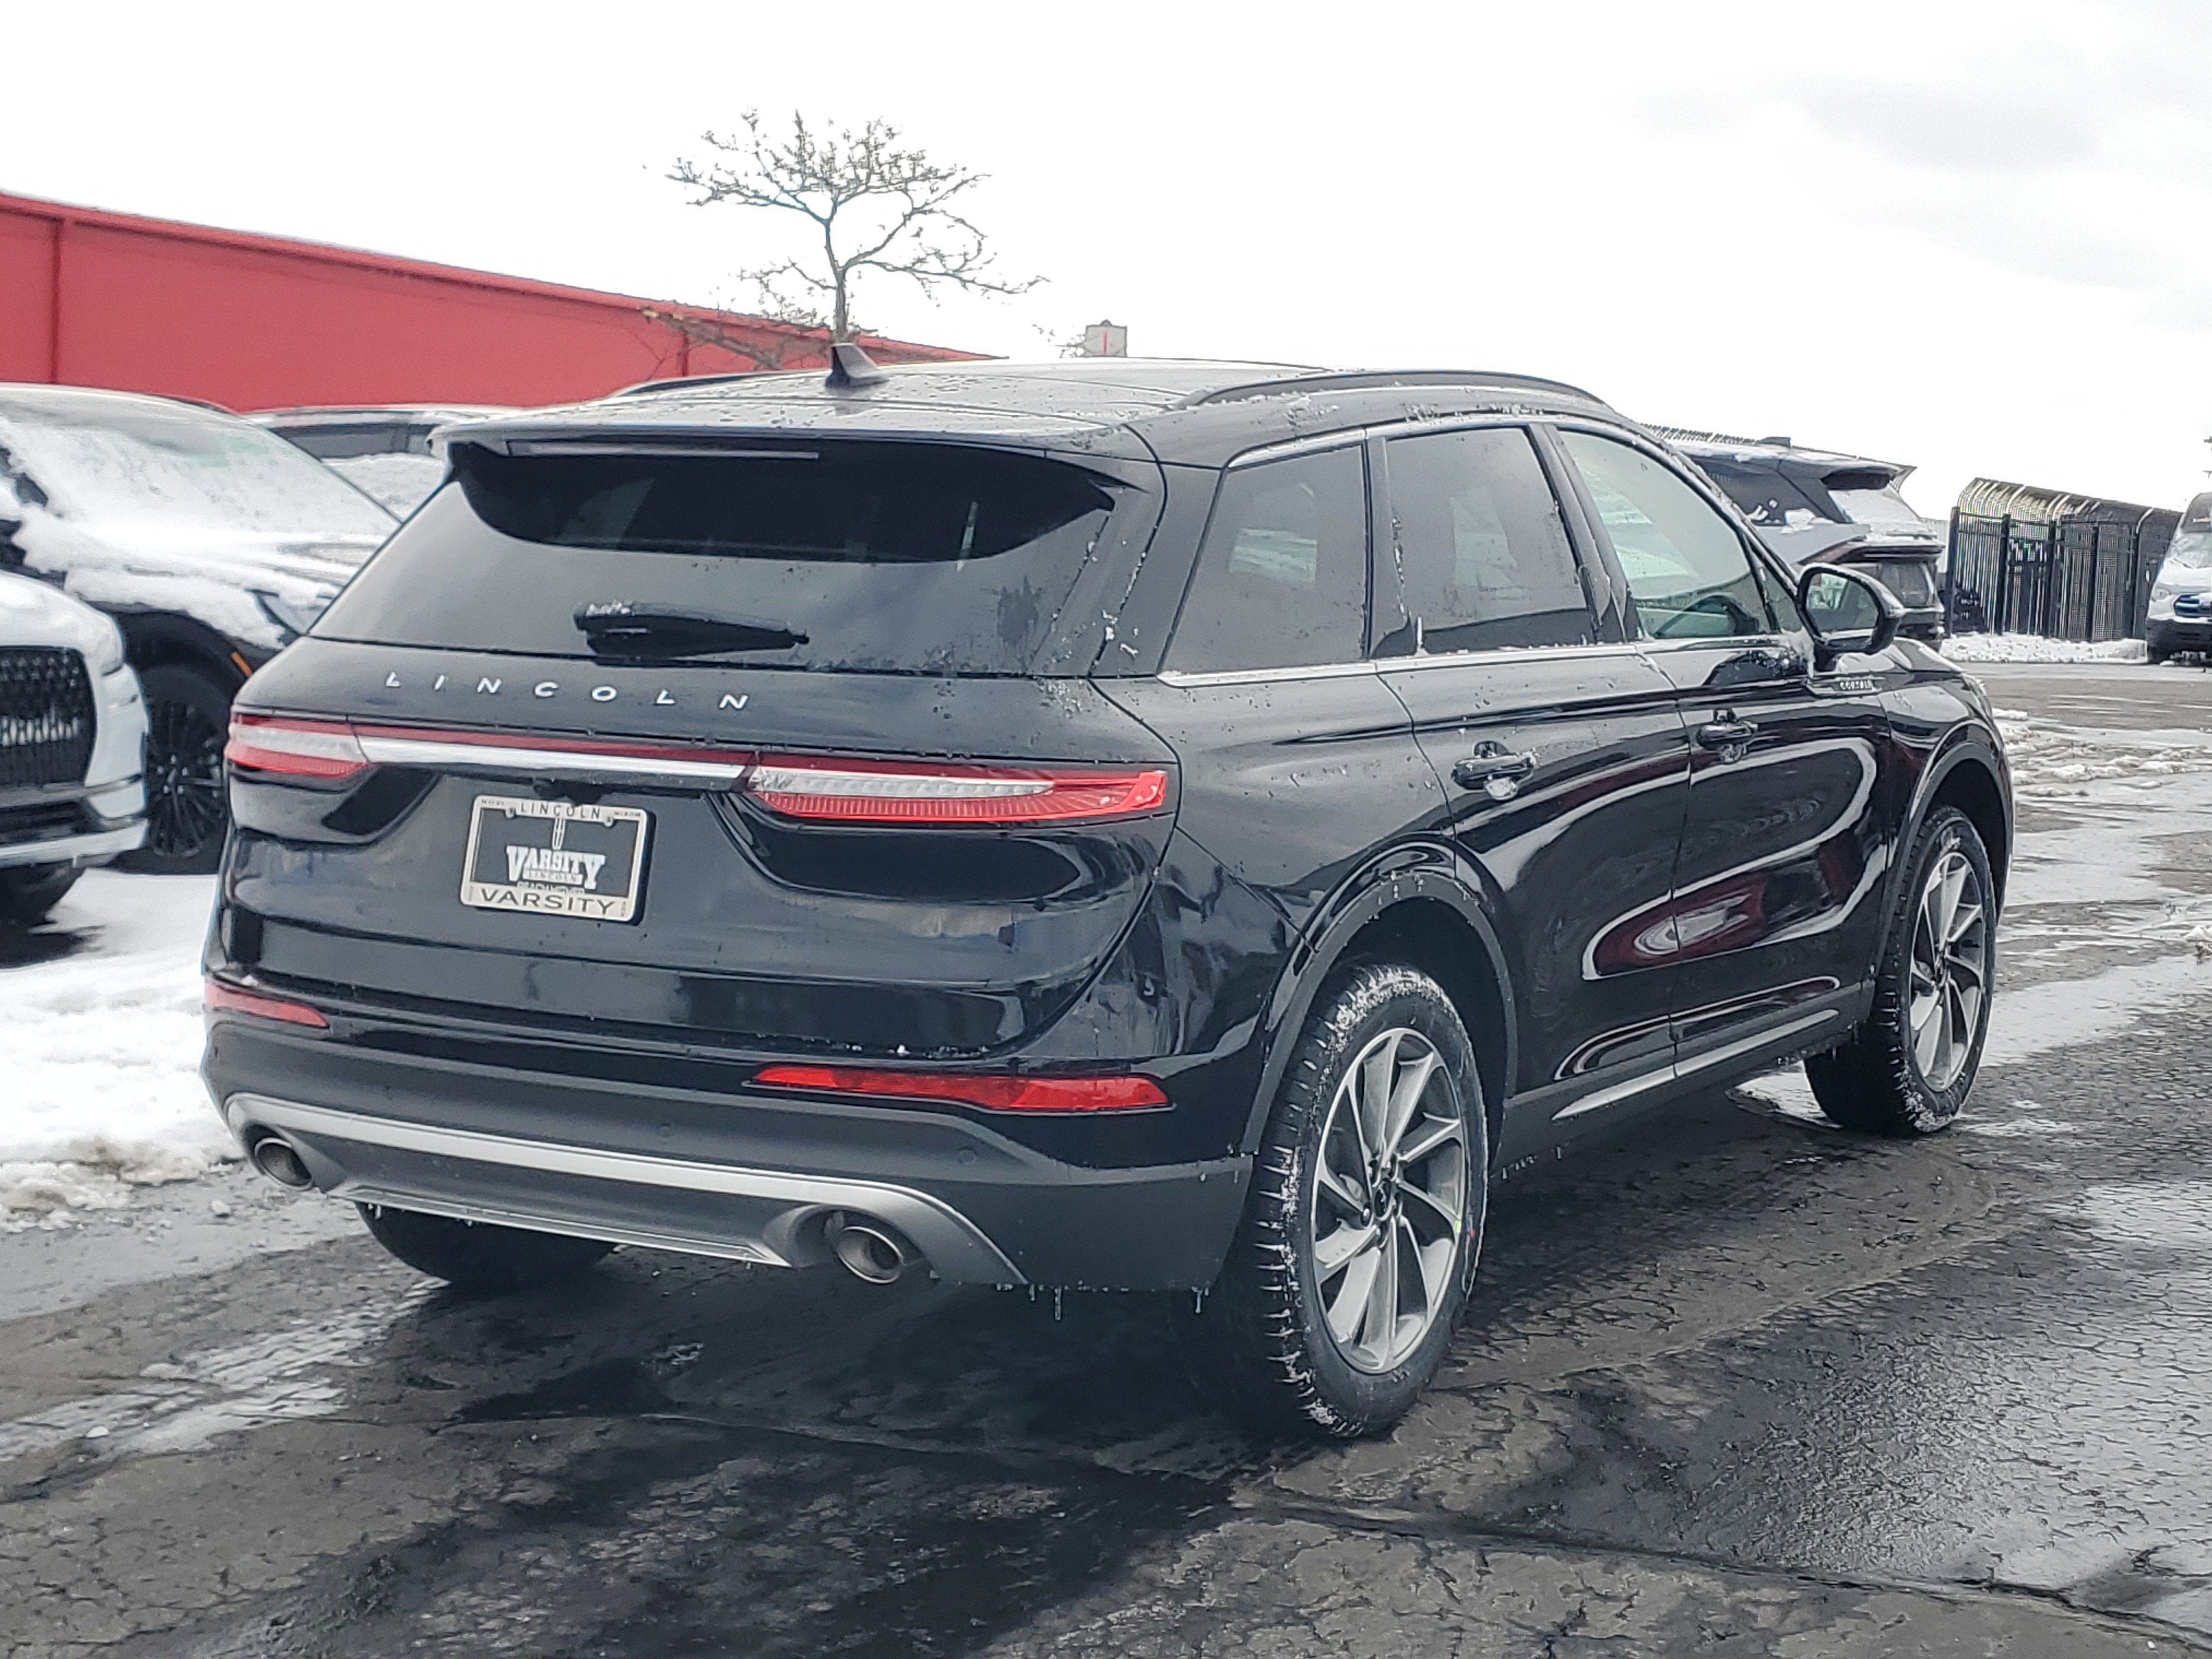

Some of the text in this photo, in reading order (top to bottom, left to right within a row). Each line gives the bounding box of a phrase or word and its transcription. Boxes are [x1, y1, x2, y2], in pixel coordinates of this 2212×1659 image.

[386, 672, 748, 709] LINCOLN
[521, 802, 601, 819] LINCOLN
[506, 845, 606, 889] VARSITY
[481, 888, 615, 915] VARSITY
